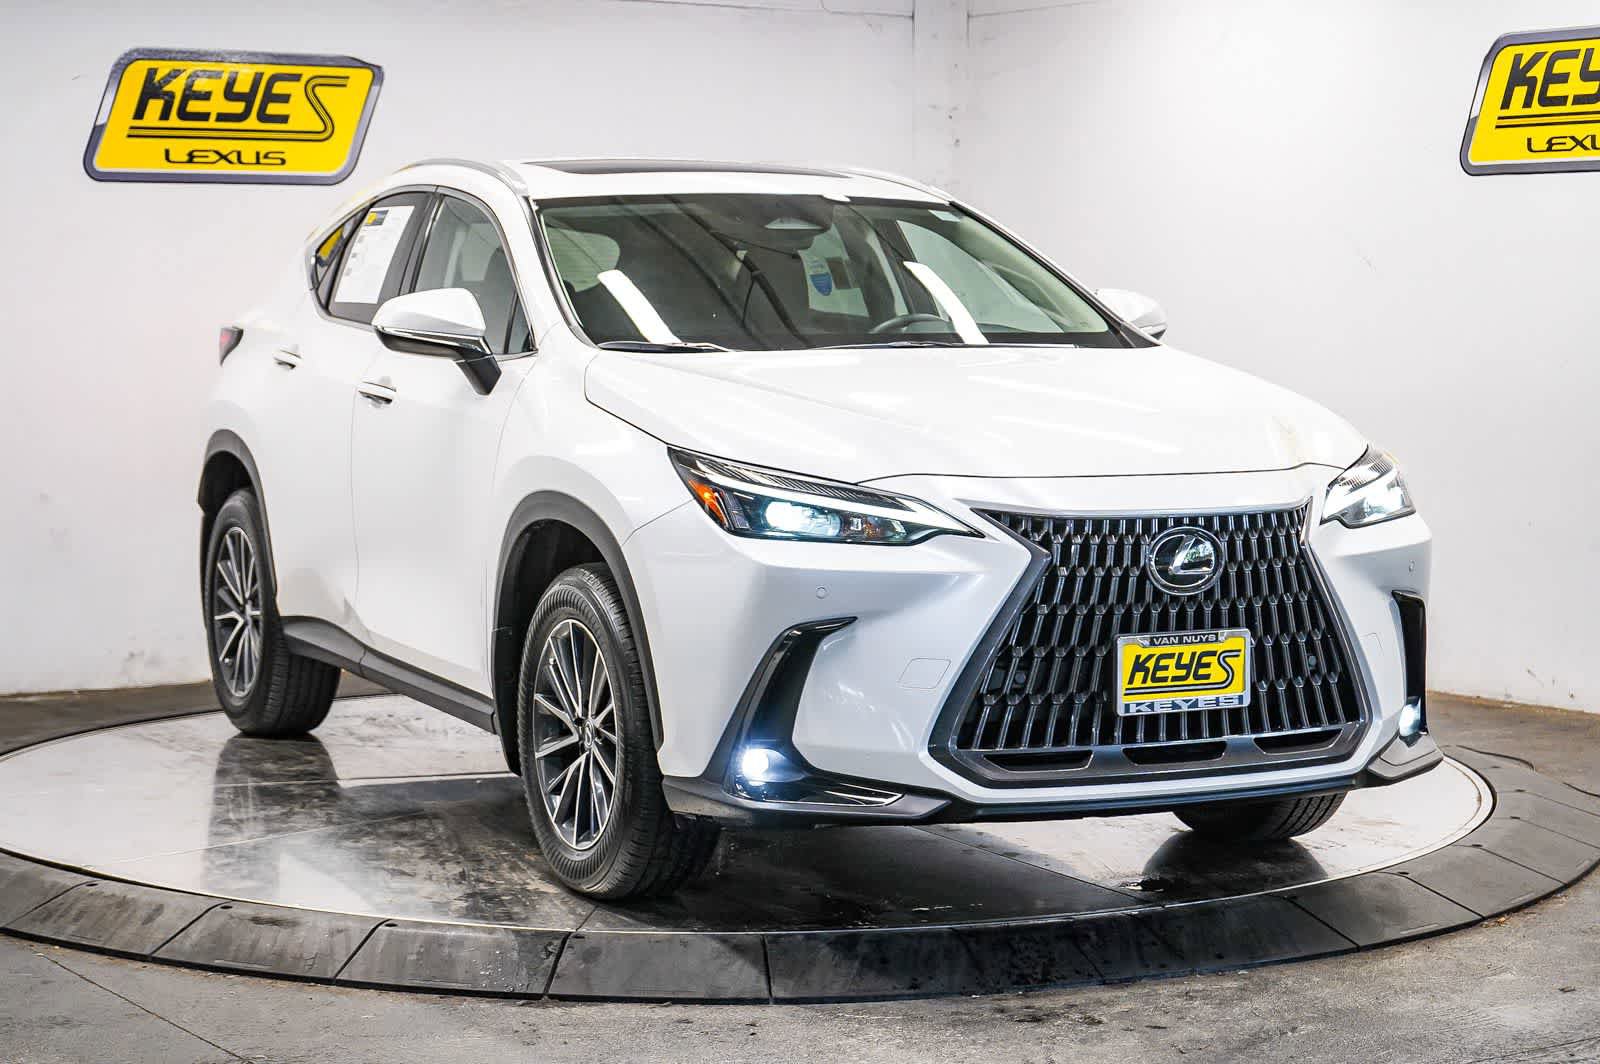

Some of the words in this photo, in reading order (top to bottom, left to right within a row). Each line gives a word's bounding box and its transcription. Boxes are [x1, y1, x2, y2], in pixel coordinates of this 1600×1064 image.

[129, 67, 350, 142] KEYES
[164, 148, 286, 166] LEXUS
[1153, 636, 1179, 645] VAN
[1183, 634, 1217, 643] NUYS
[1124, 649, 1242, 695] KEYES
[1128, 696, 1239, 713] KEYES
